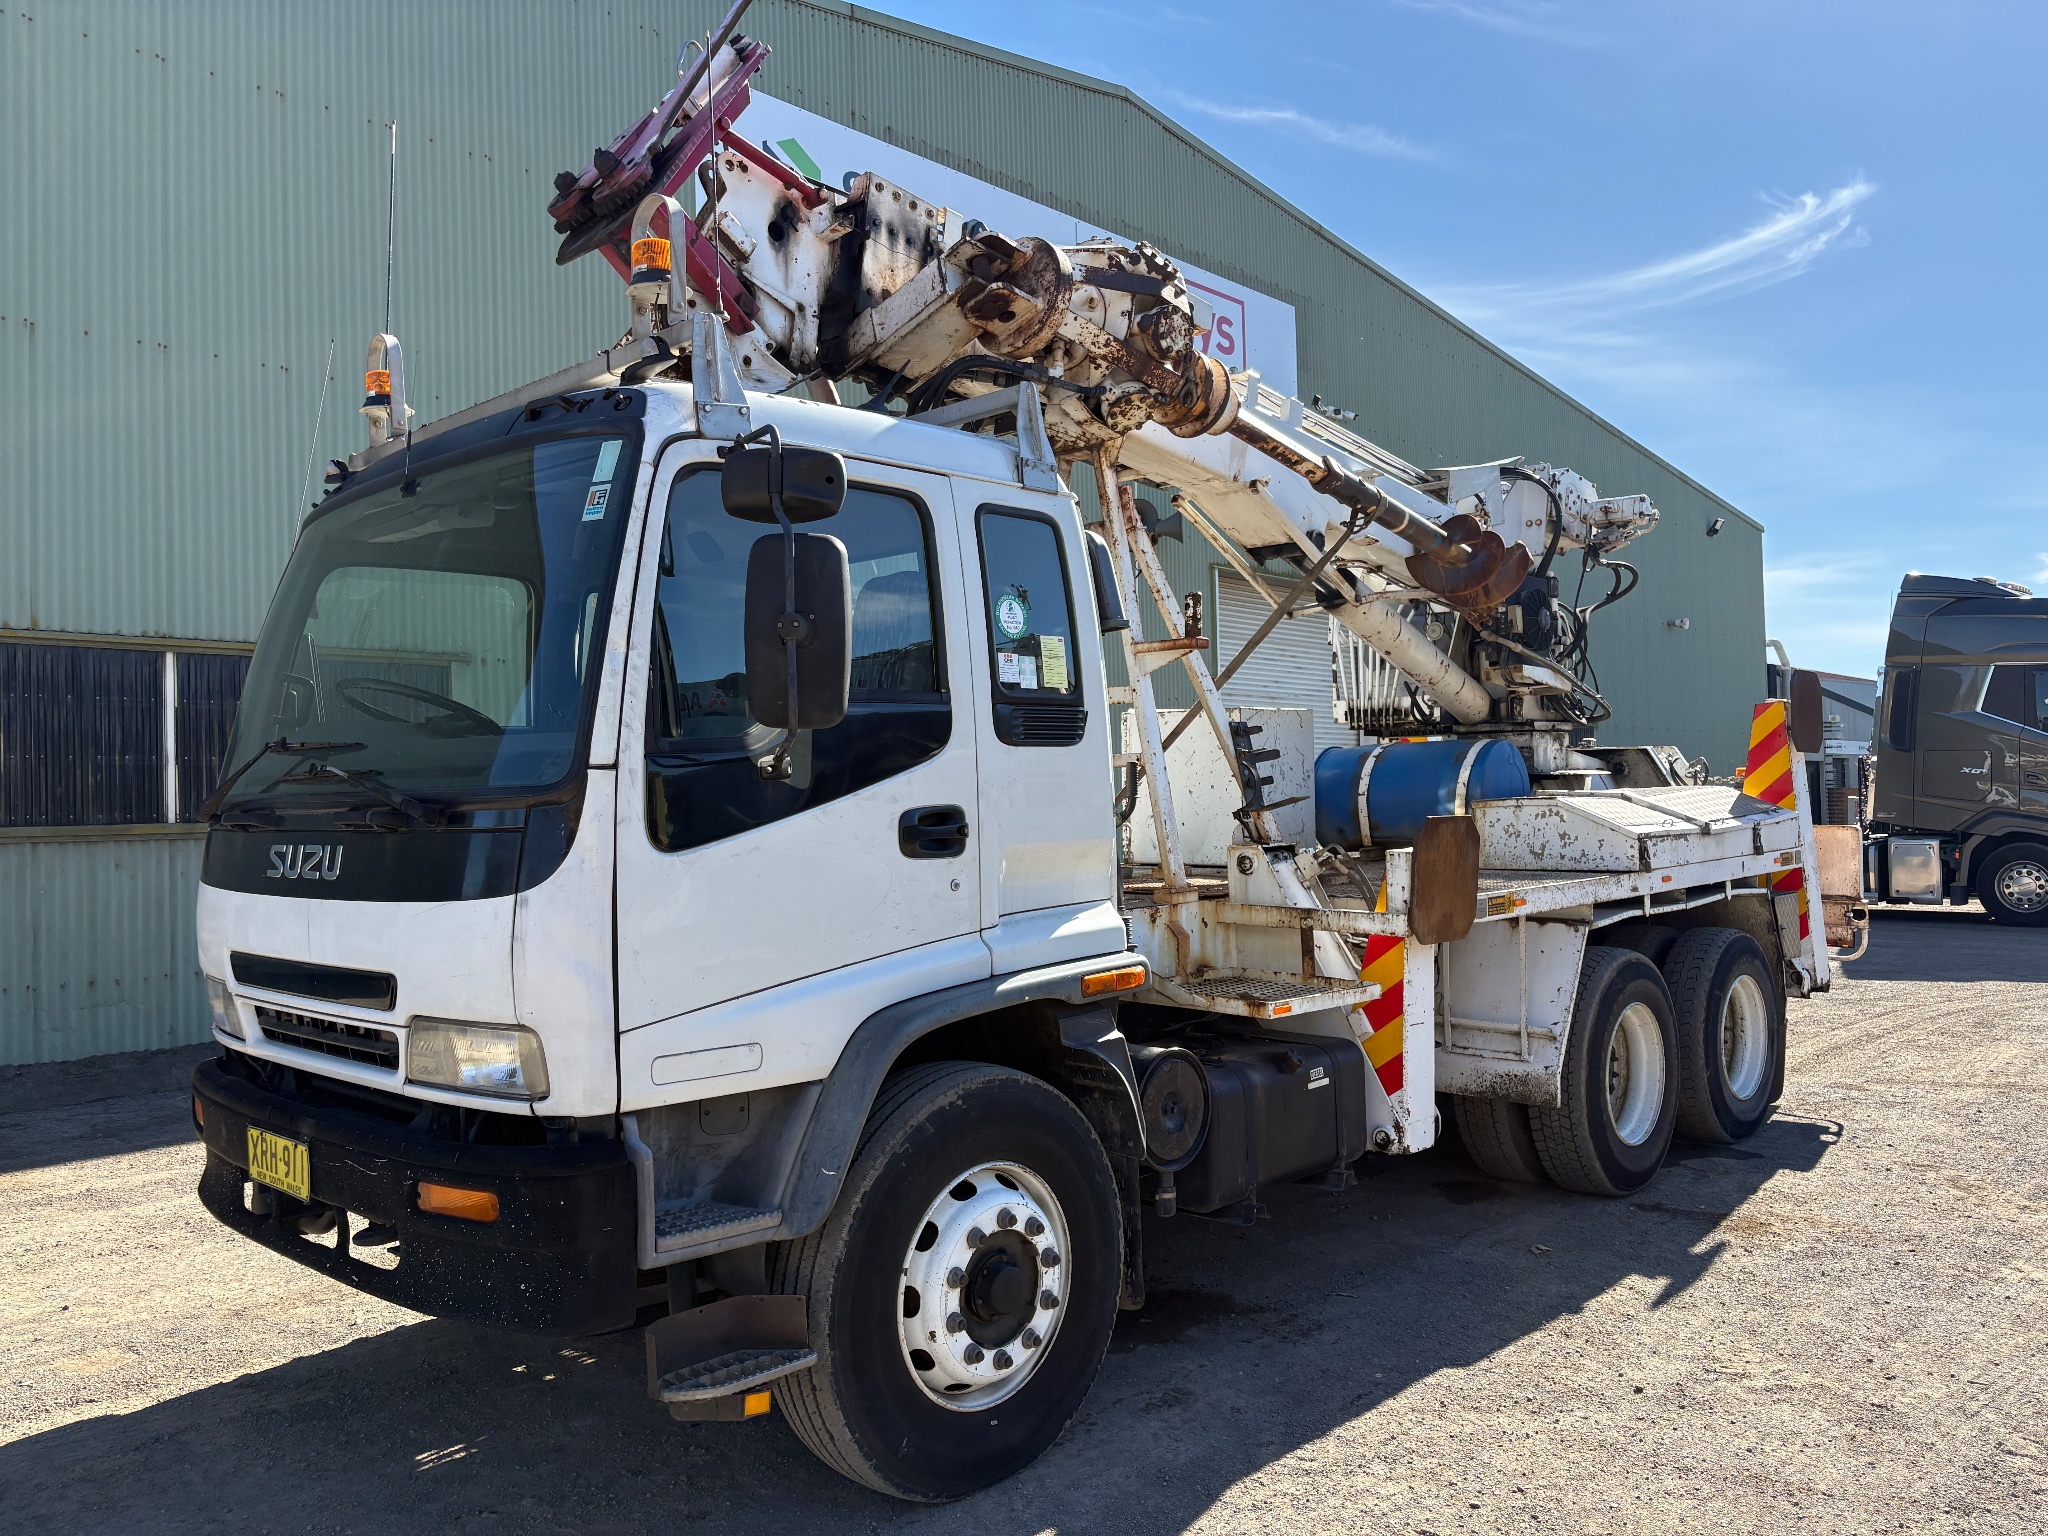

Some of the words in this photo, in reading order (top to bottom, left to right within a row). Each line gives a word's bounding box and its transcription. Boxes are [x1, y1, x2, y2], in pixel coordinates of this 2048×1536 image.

[266, 844, 344, 880] SUZU
[1310, 1068, 1324, 1079] DIESEL
[256, 1169, 267, 1181] NEW
[269, 1174, 285, 1188] SOUTH
[286, 1182, 302, 1196] WALES
